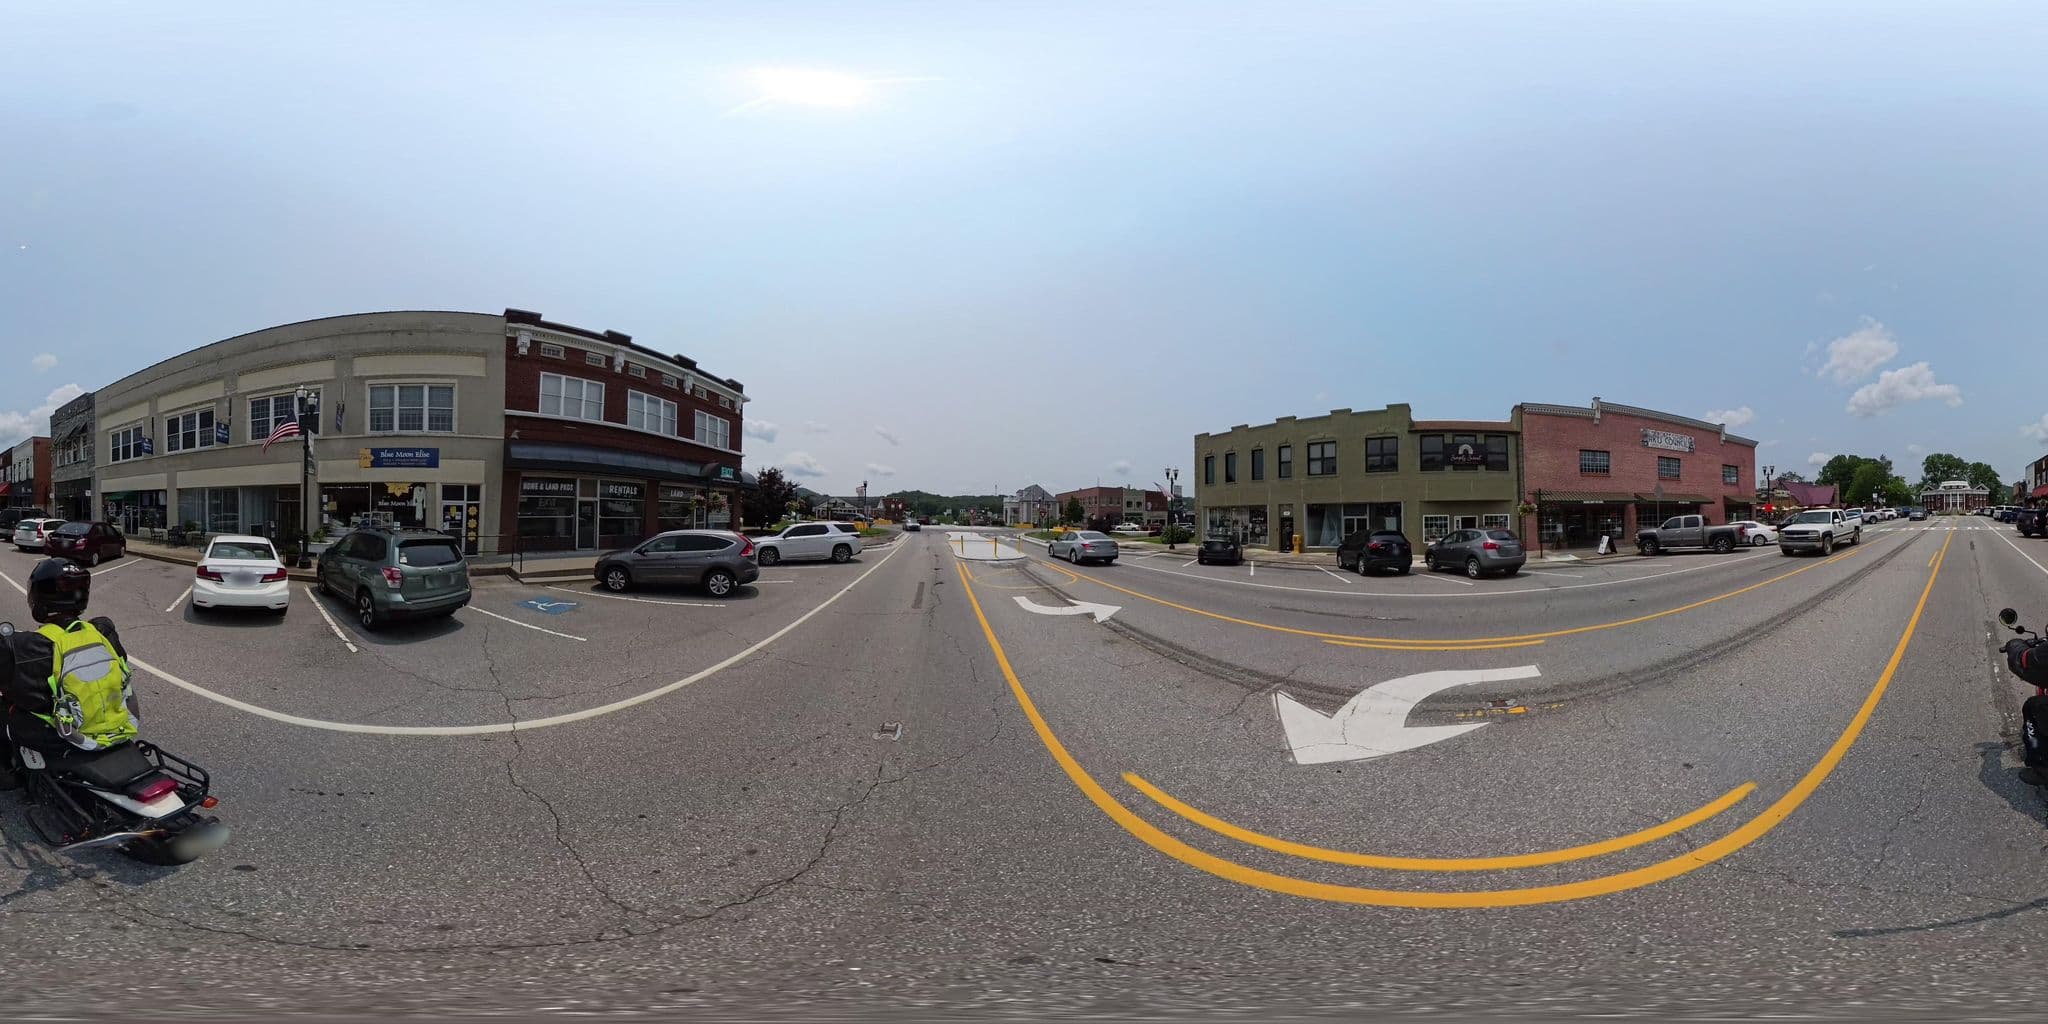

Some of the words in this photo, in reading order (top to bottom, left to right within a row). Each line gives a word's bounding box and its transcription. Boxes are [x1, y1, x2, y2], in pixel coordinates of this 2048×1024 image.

[380, 449, 394, 458] Blue
[415, 450, 430, 458] Elise
[523, 482, 539, 490] HOME
[545, 482, 559, 490] LAND
[609, 485, 638, 496] RENTALS
[671, 489, 685, 498] LAND
